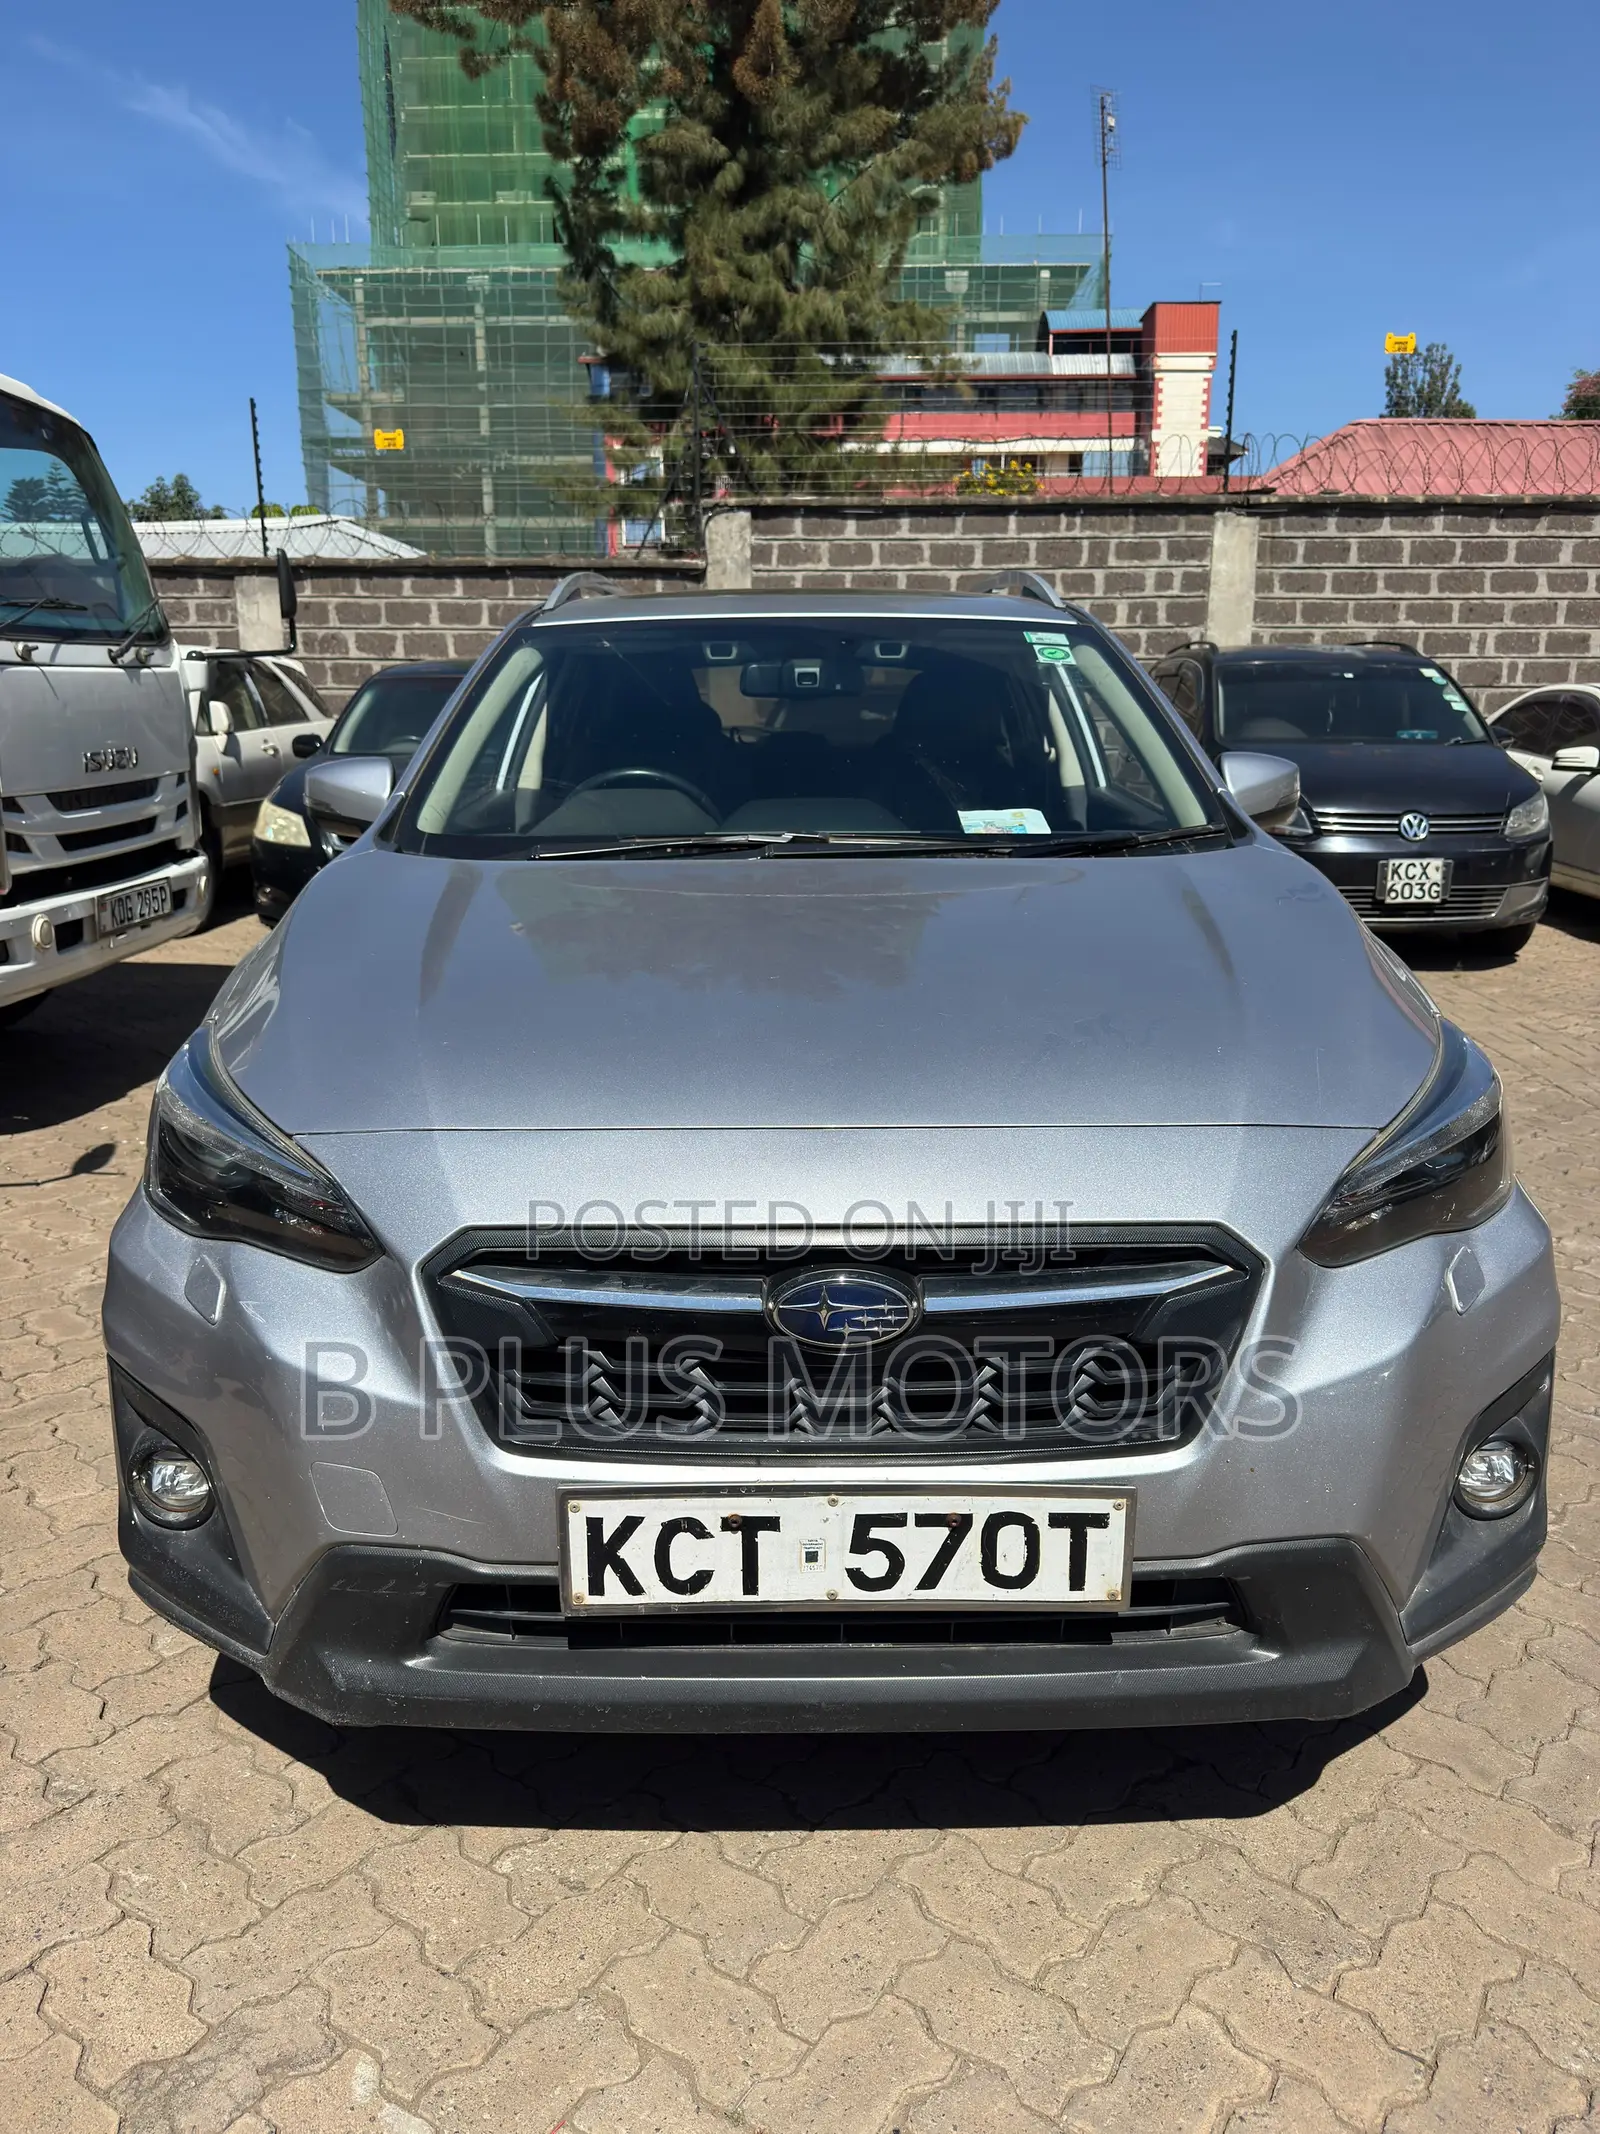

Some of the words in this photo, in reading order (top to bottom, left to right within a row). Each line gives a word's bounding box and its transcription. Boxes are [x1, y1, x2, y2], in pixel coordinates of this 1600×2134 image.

[81, 746, 138, 773] ISUZU
[1391, 862, 1430, 880] KCX
[1388, 882, 1441, 900] 603G
[110, 895, 134, 928] KDG
[586, 1515, 781, 1596] KCT
[845, 1511, 1110, 1592] 570T
